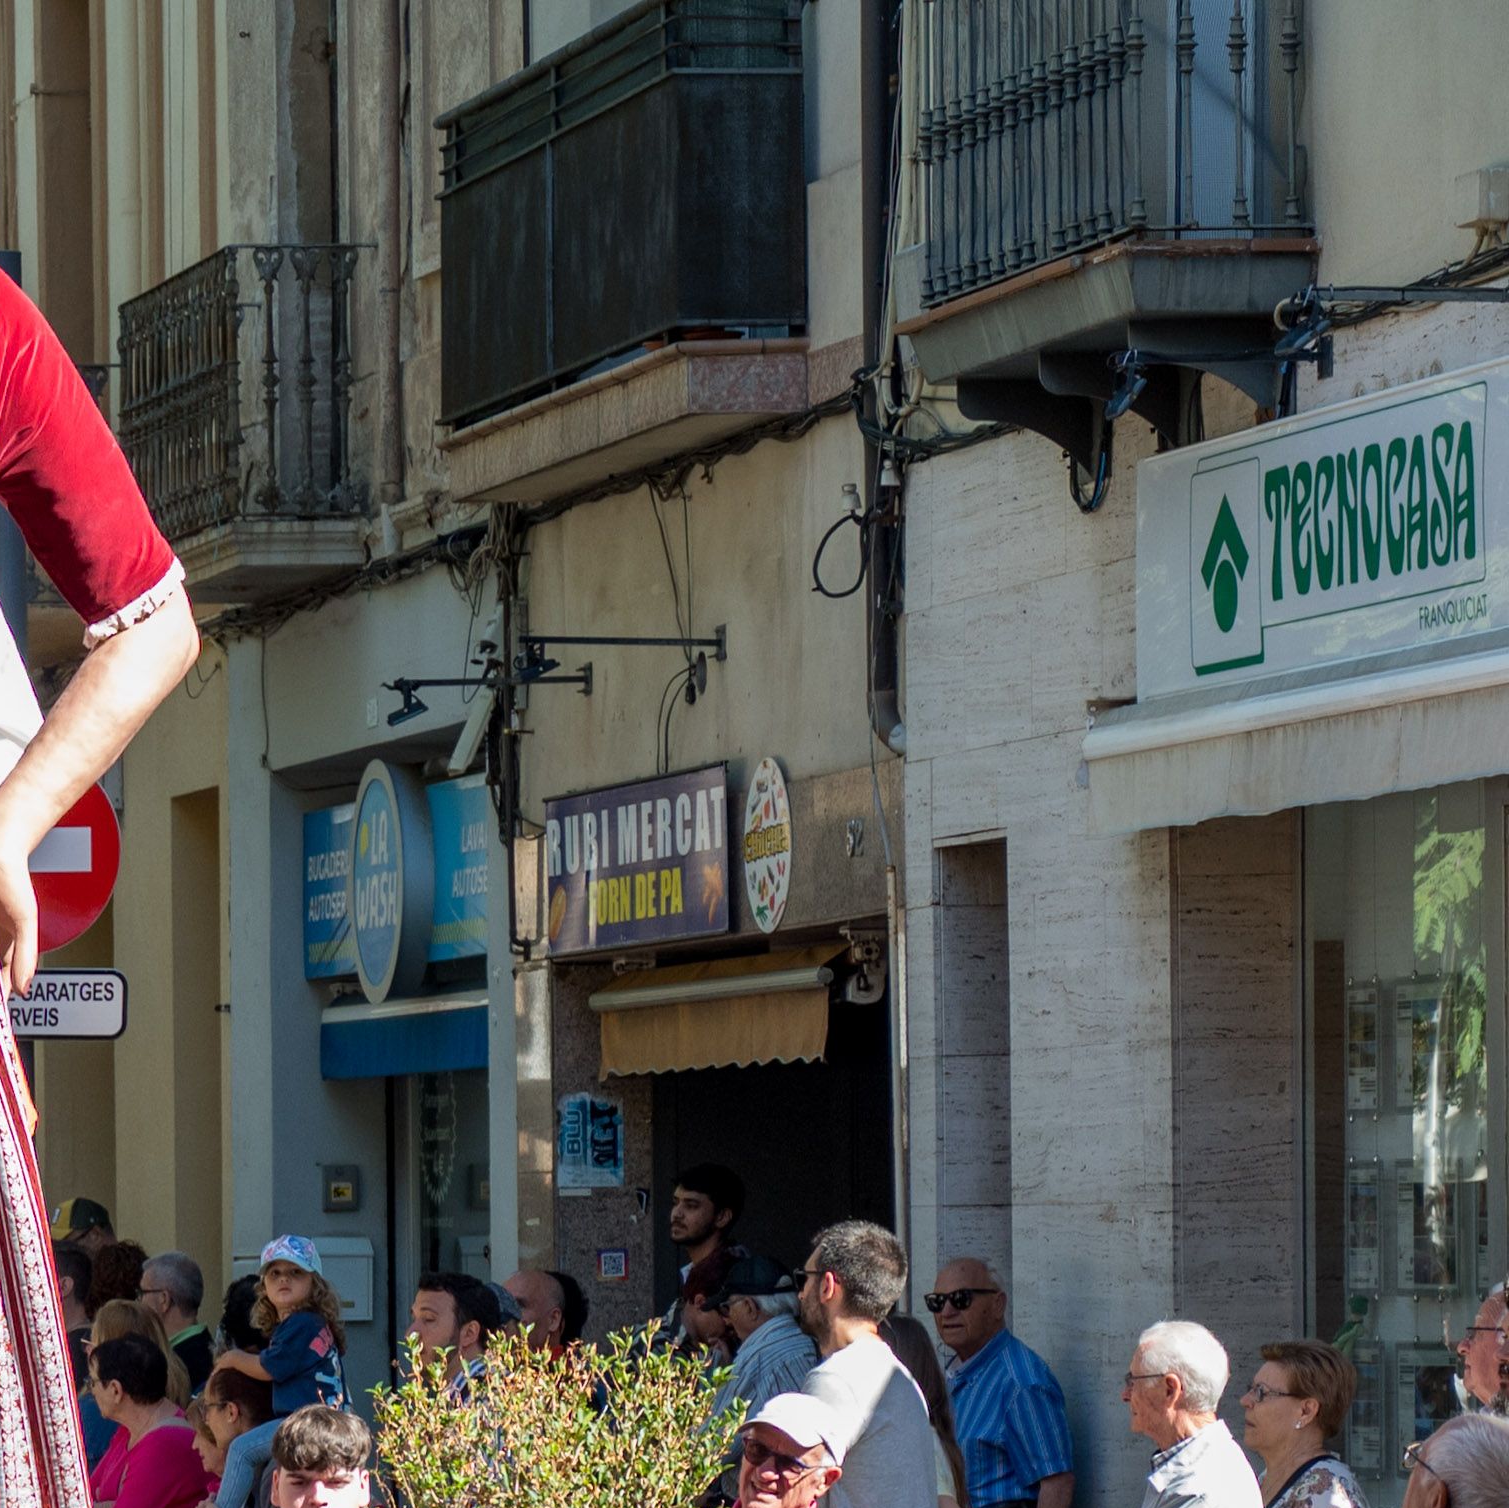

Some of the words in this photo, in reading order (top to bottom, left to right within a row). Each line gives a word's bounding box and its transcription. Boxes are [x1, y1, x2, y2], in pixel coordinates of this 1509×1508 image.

[1264, 420, 1477, 602] TECNOCASA
[1418, 594, 1489, 631] FRANQUICIAT
[370, 810, 389, 866] LA
[546, 809, 610, 877] RUBI
[617, 786, 725, 866] MERCAT
[356, 872, 398, 931] WASH
[635, 871, 657, 920] DE
[660, 867, 684, 916] PA
[22, 982, 115, 1002] GARATGES
